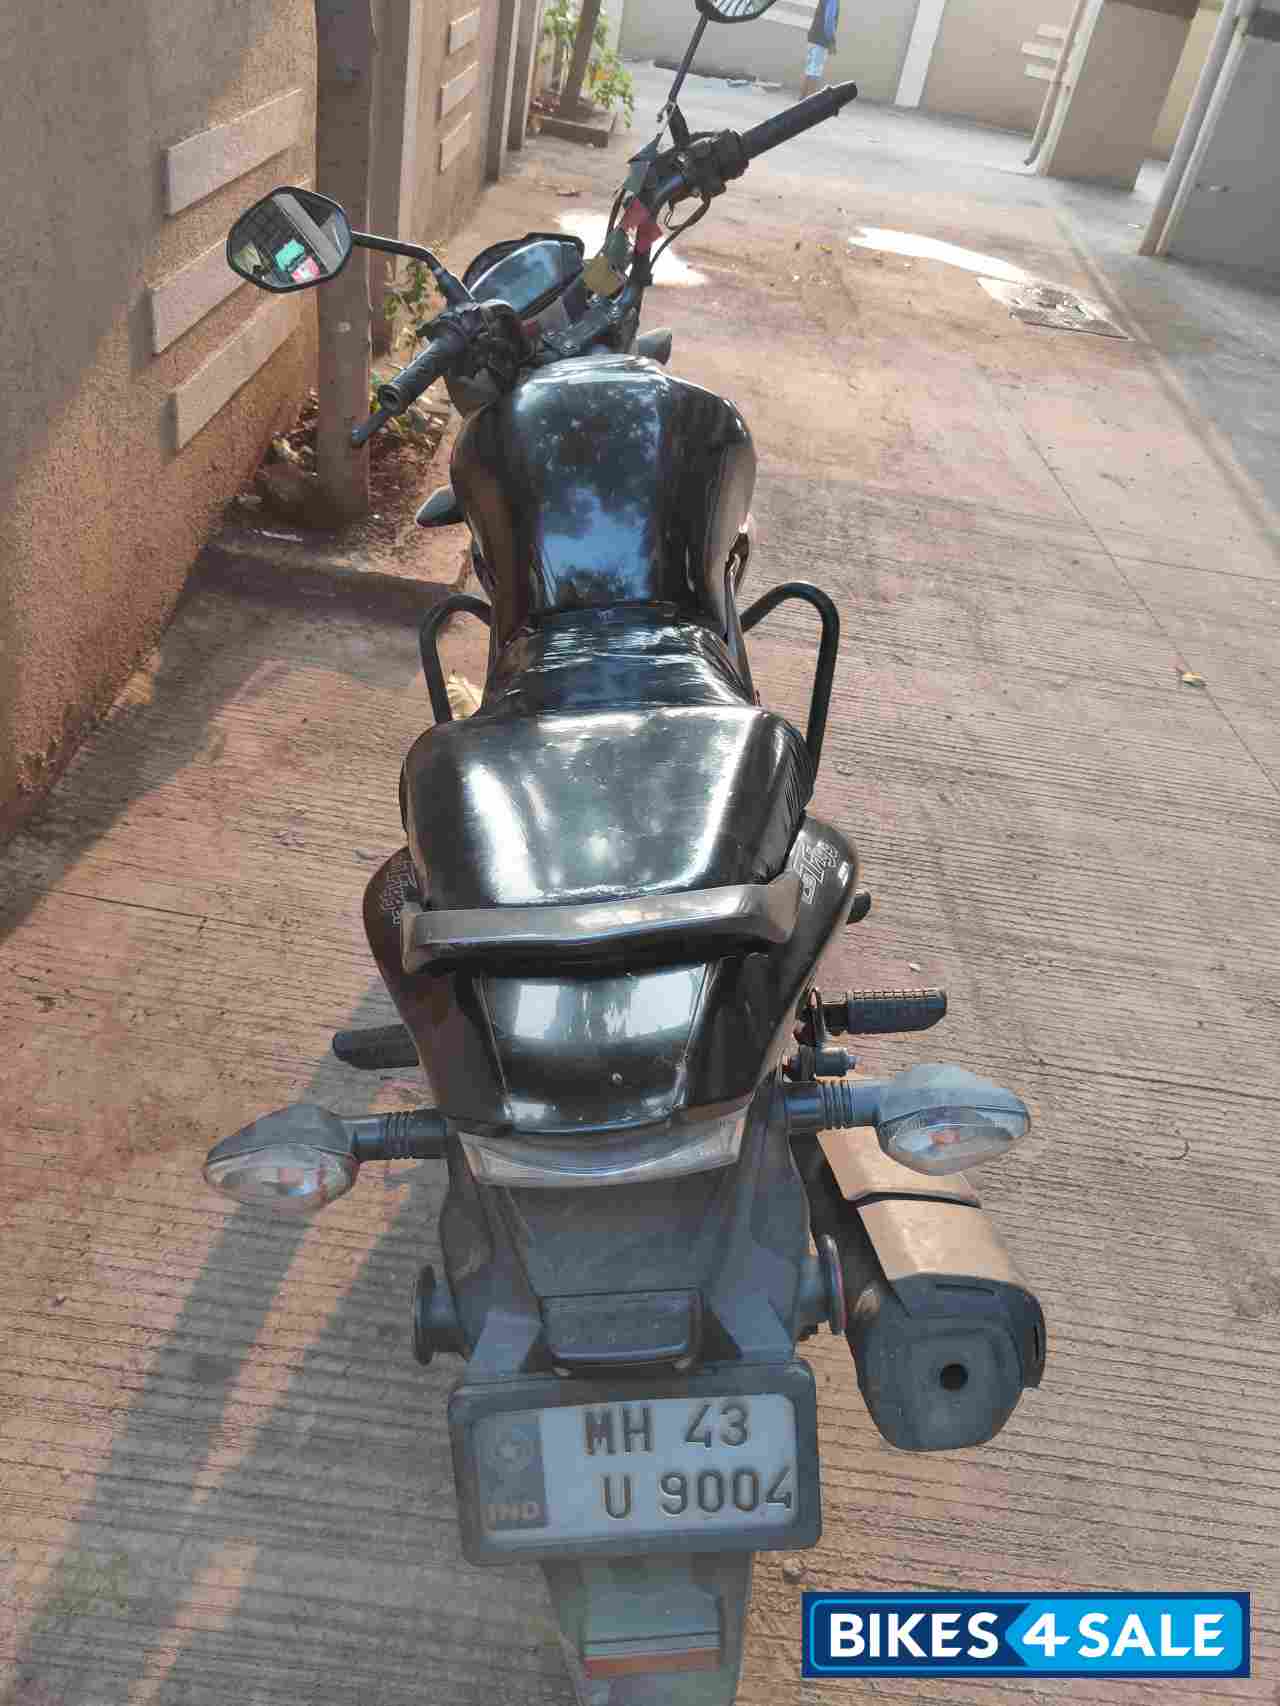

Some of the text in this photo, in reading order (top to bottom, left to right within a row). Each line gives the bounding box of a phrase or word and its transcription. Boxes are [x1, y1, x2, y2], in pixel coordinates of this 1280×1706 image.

[583, 1403, 750, 1456] MH 43
[602, 1467, 794, 1520] U 9004
